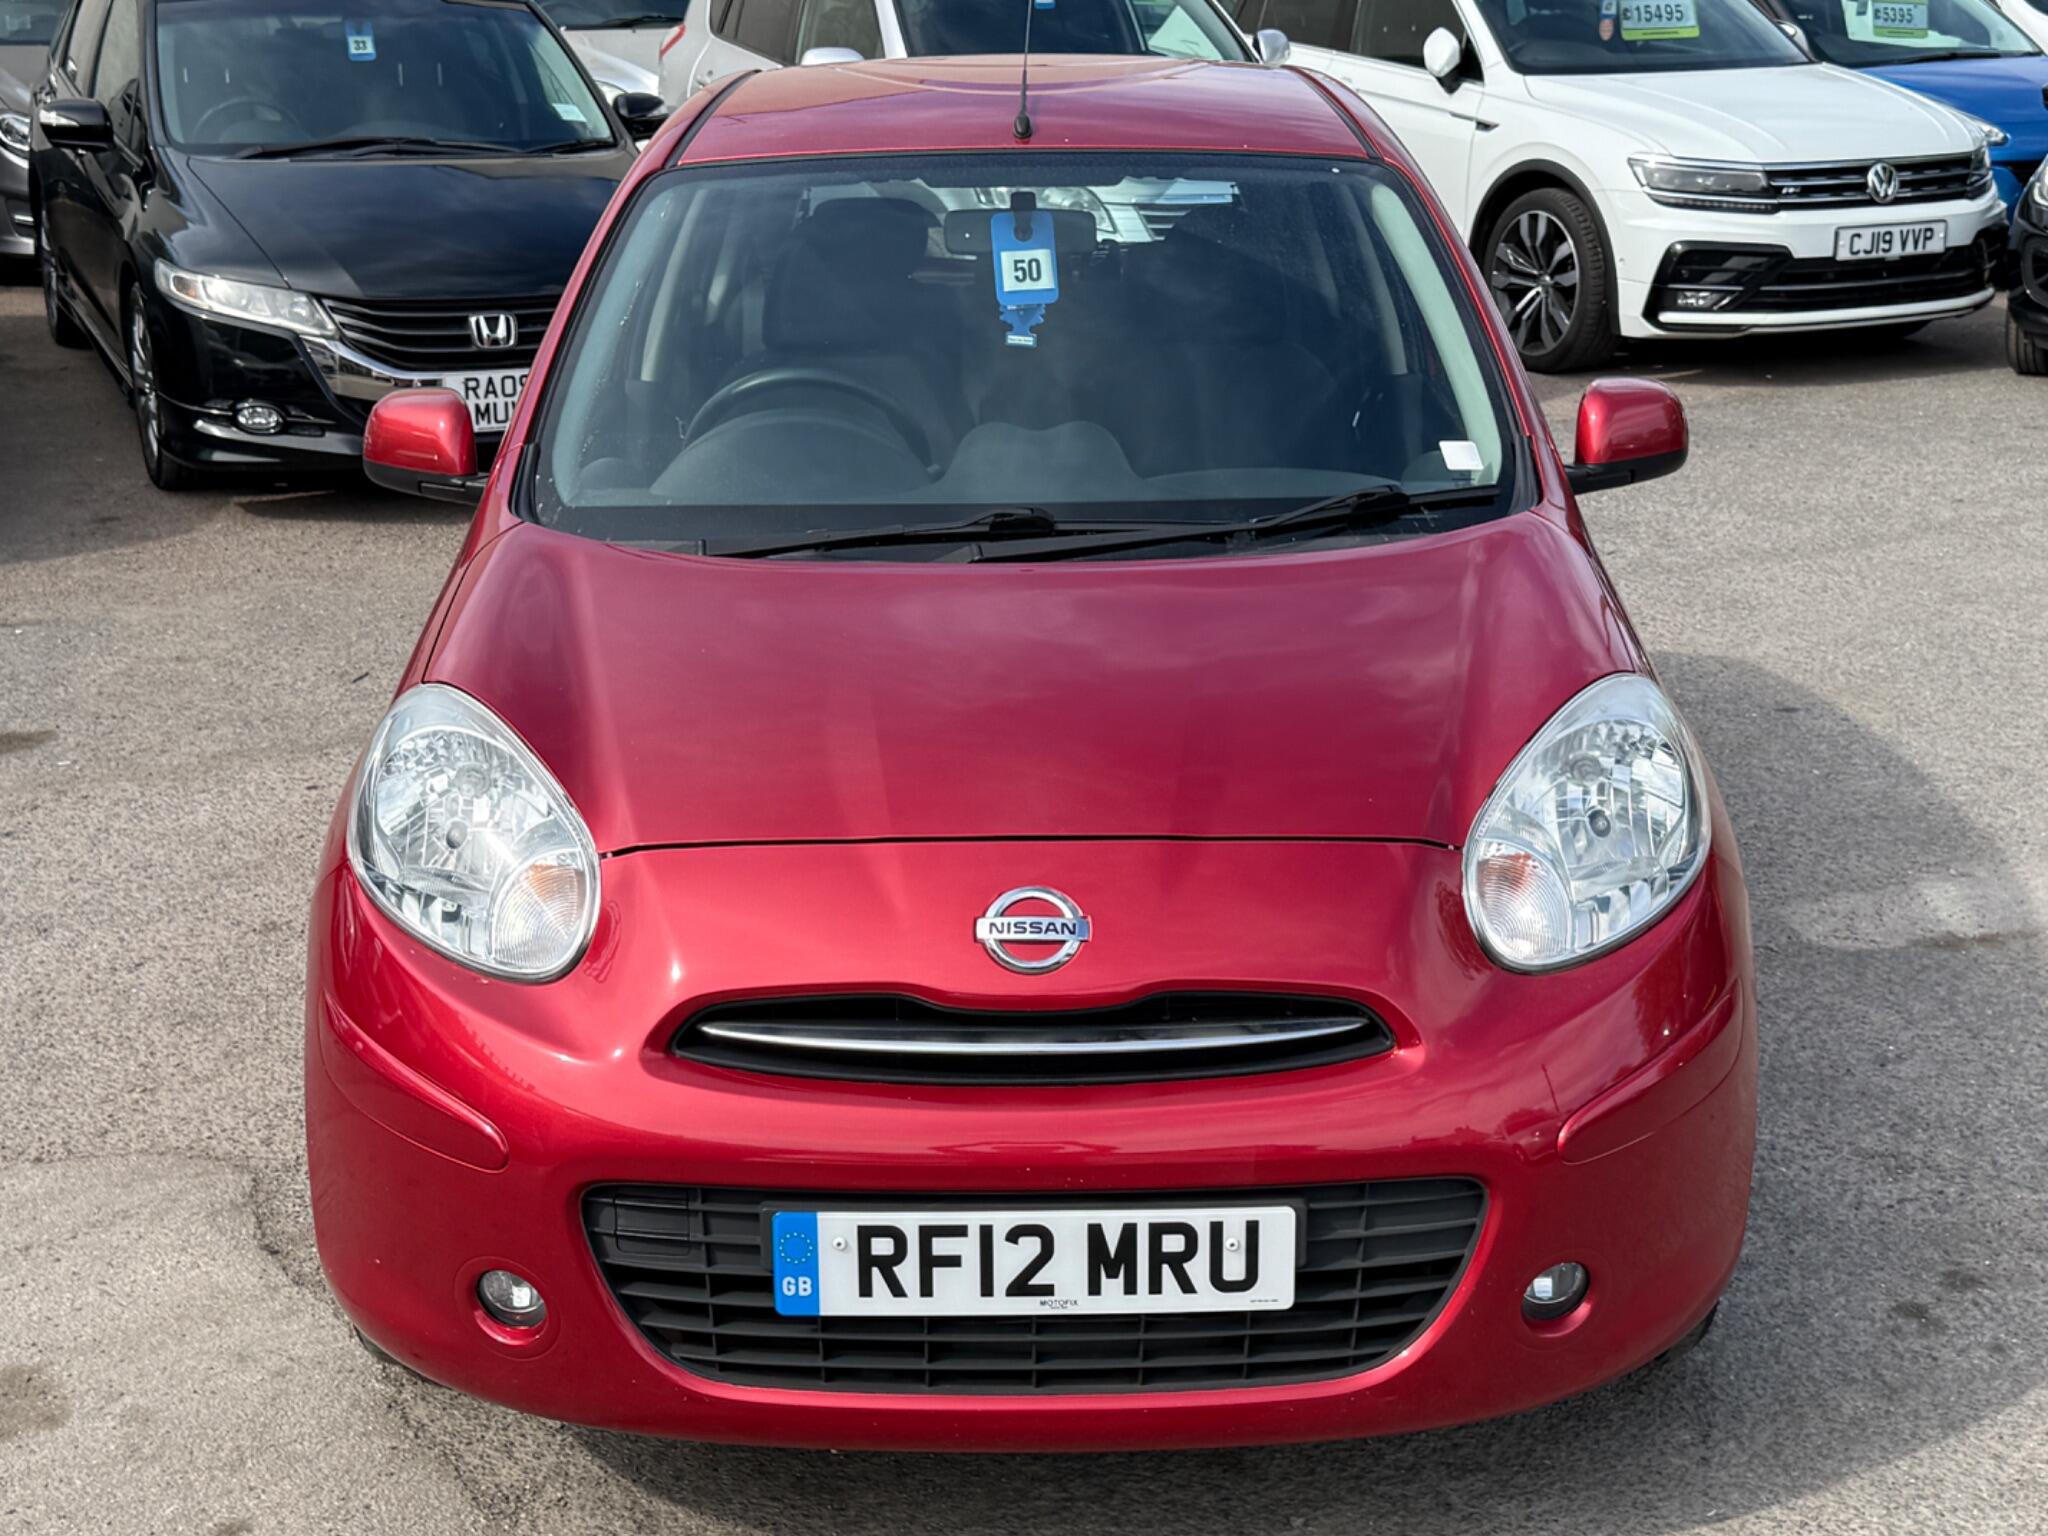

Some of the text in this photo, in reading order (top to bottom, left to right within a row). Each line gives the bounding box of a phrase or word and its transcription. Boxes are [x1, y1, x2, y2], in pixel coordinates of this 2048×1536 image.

[1849, 227, 1934, 255] CJ19 VVP
[1013, 258, 1042, 283] 50
[989, 921, 1077, 936] NISSAN
[856, 1219, 1260, 1298] RF12 MRU
[782, 1276, 812, 1297] GB
